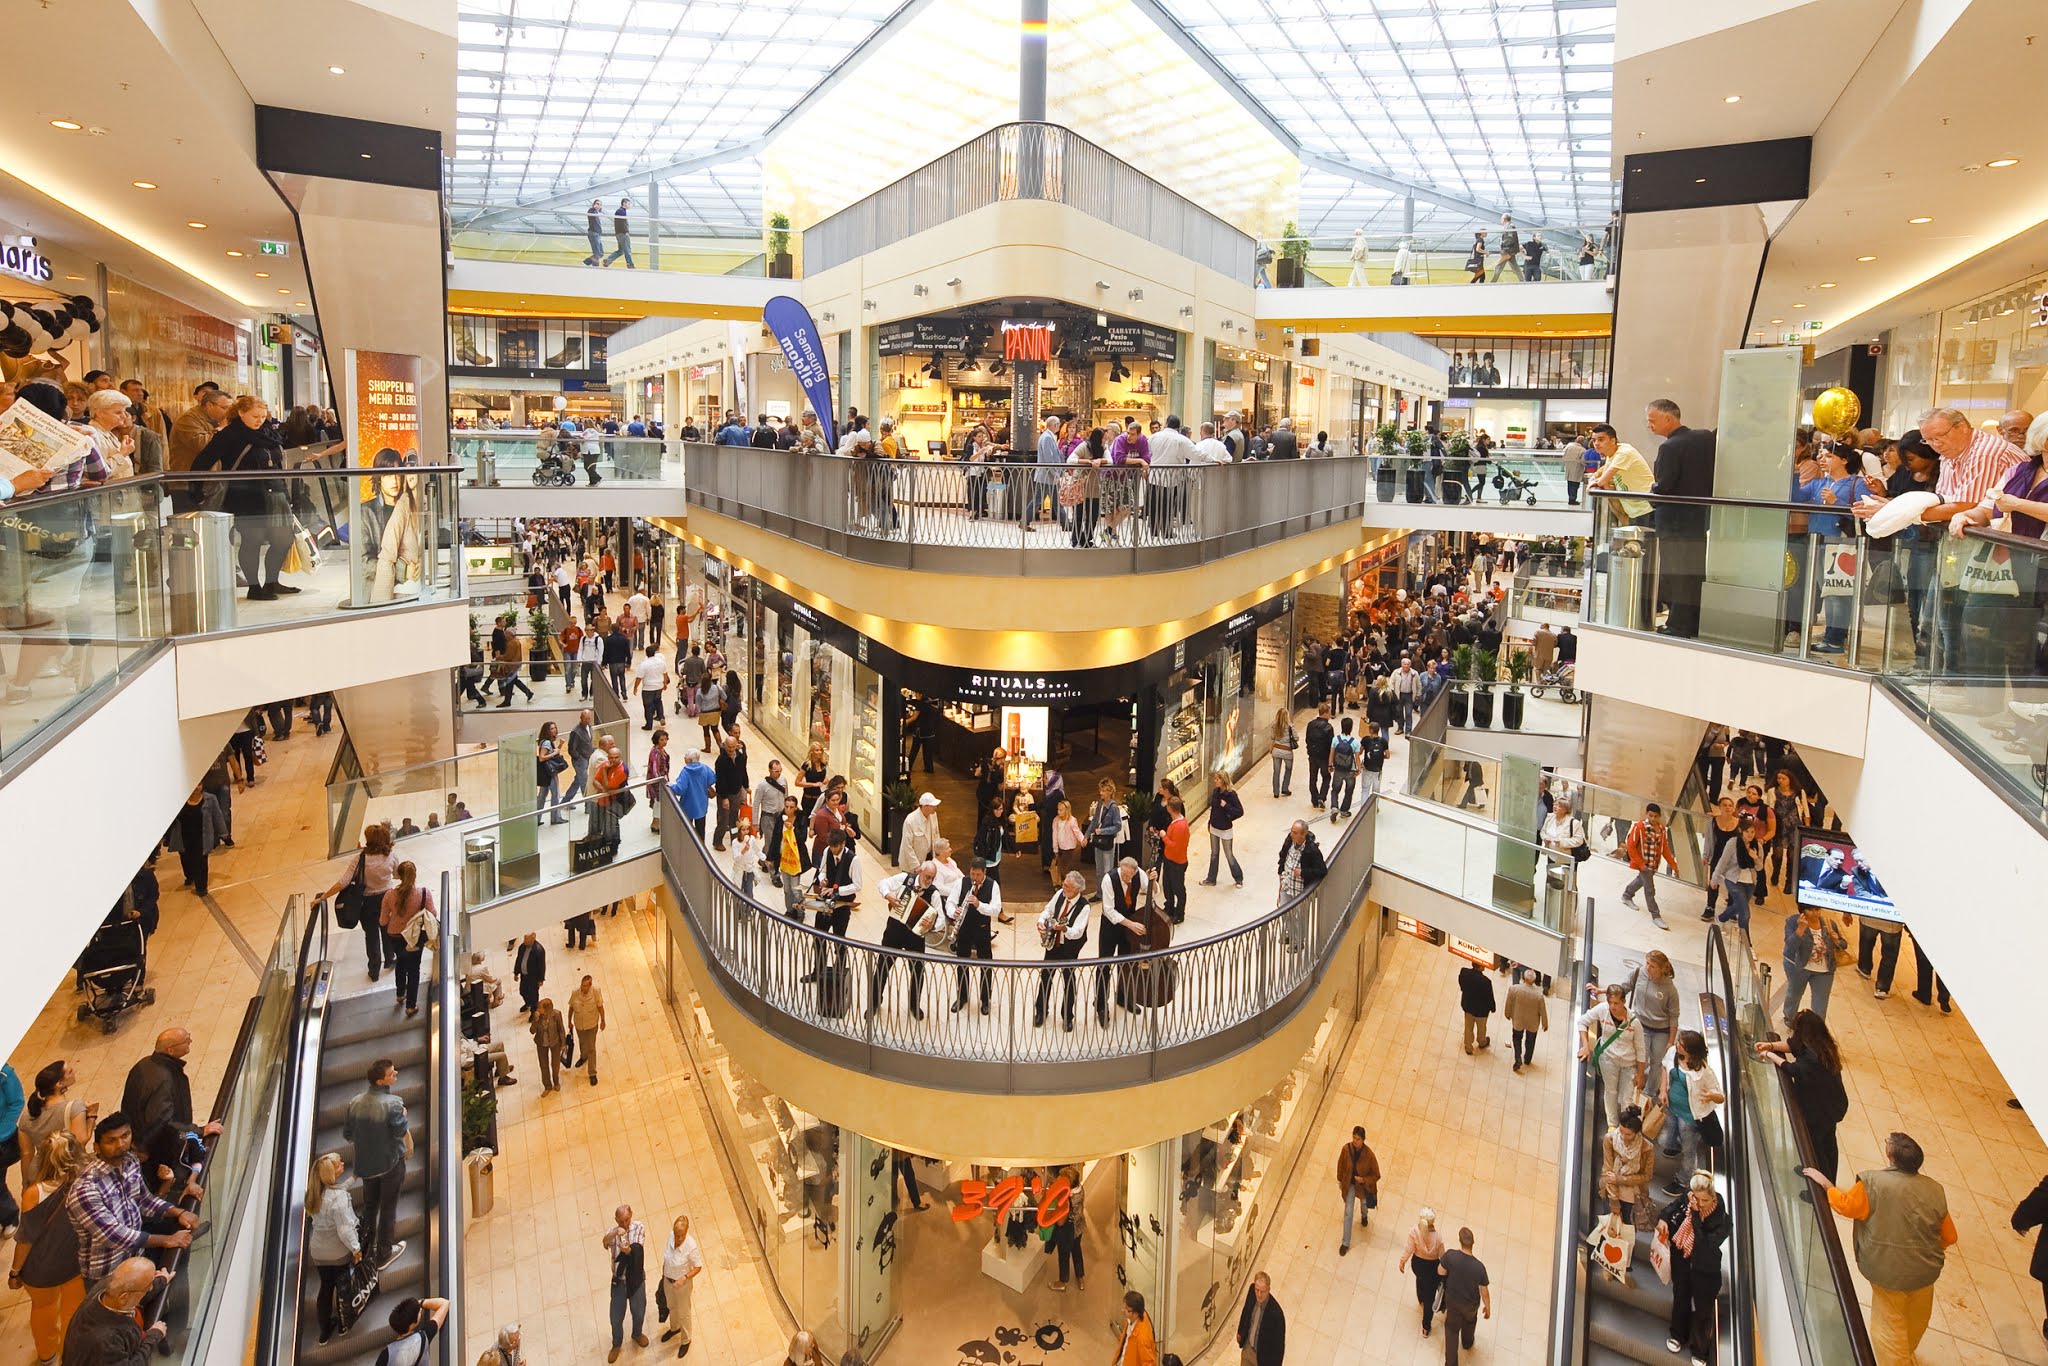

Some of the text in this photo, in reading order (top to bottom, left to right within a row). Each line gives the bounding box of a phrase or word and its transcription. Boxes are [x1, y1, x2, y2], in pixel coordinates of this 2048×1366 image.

[269, 325, 281, 338] P
[917, 323, 933, 331] Pane
[1006, 327, 1051, 361] PANINI
[794, 328, 827, 383] Samsung
[368, 379, 404, 393] SHOPPEN
[368, 392, 393, 405] MEHR
[0, 516, 50, 538] didas
[1827, 552, 1837, 575] I
[958, 687, 983, 696] home
[1001, 691, 1026, 699] body
[1032, 691, 1081, 699] cosmetics
[578, 845, 611, 861] MANGO
[1830, 897, 1869, 911] Sparpaket
[351, 1270, 379, 1308] ONLY
